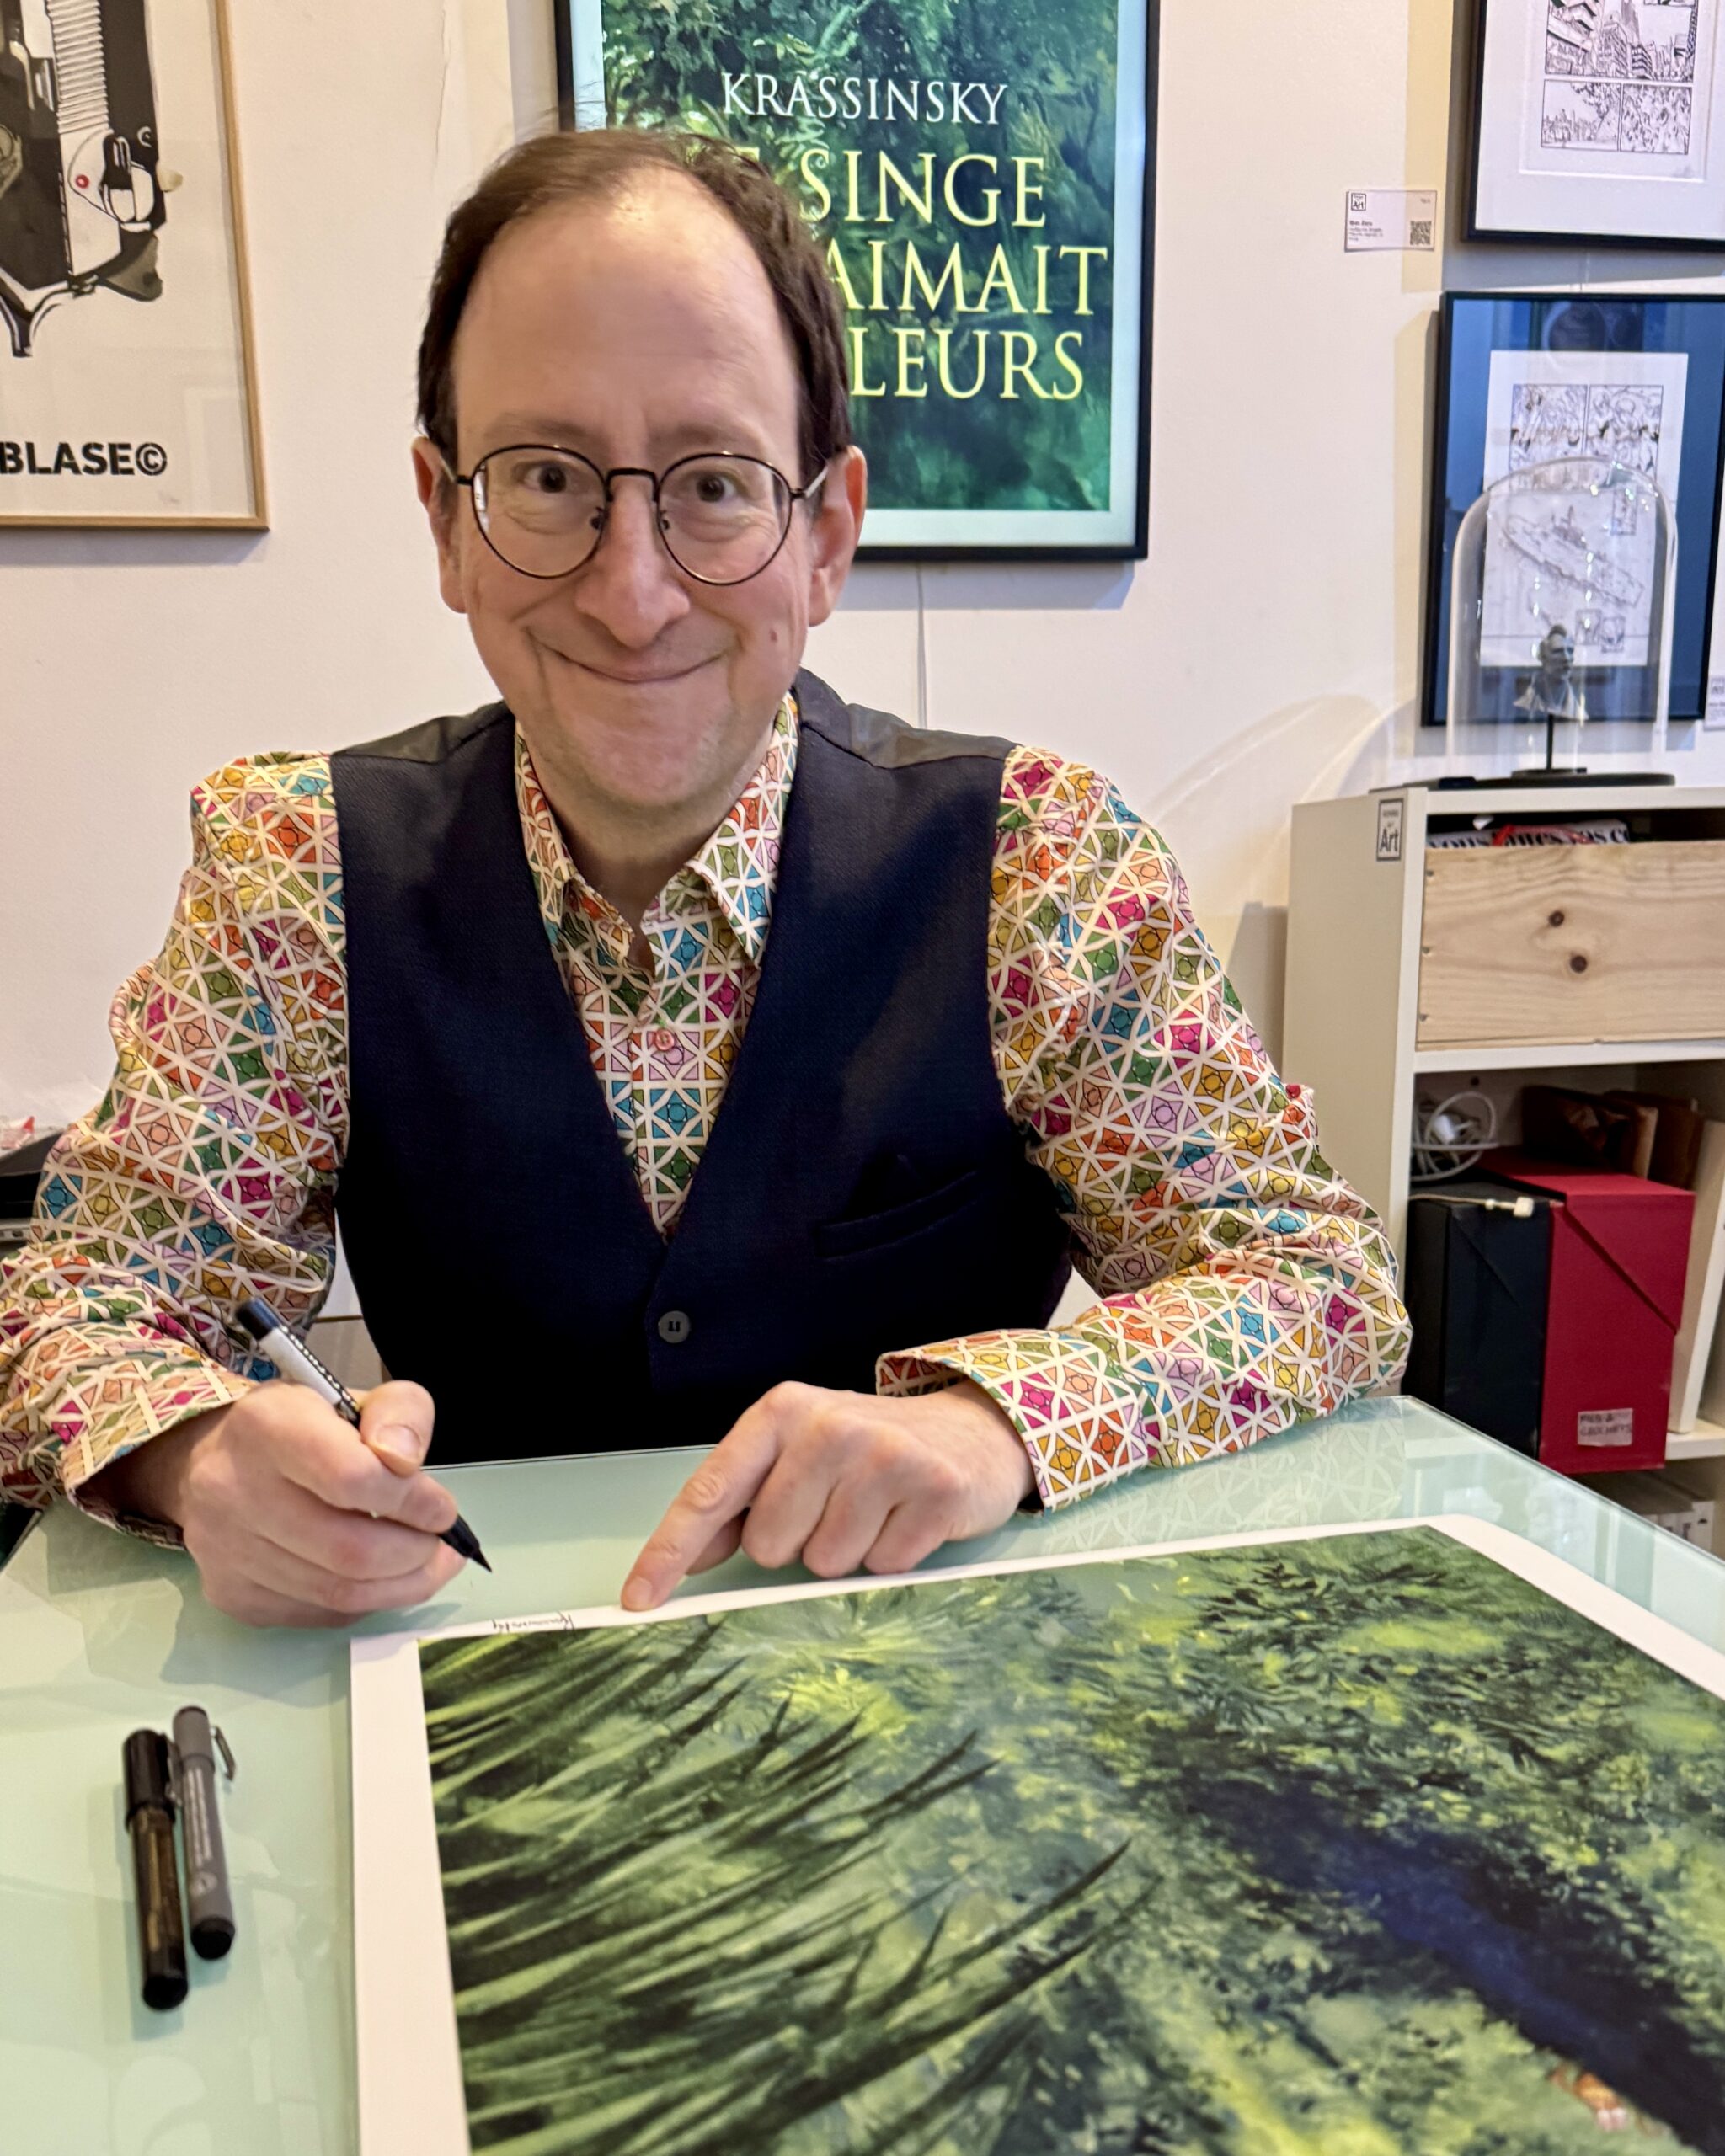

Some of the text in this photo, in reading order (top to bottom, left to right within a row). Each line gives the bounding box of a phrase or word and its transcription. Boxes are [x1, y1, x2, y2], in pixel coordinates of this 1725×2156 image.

[721, 71, 1008, 125] KRASSINSKY
[799, 148, 1046, 227] SINGE
[847, 327, 1084, 401] LEURS
[1379, 827, 1399, 852] Art
